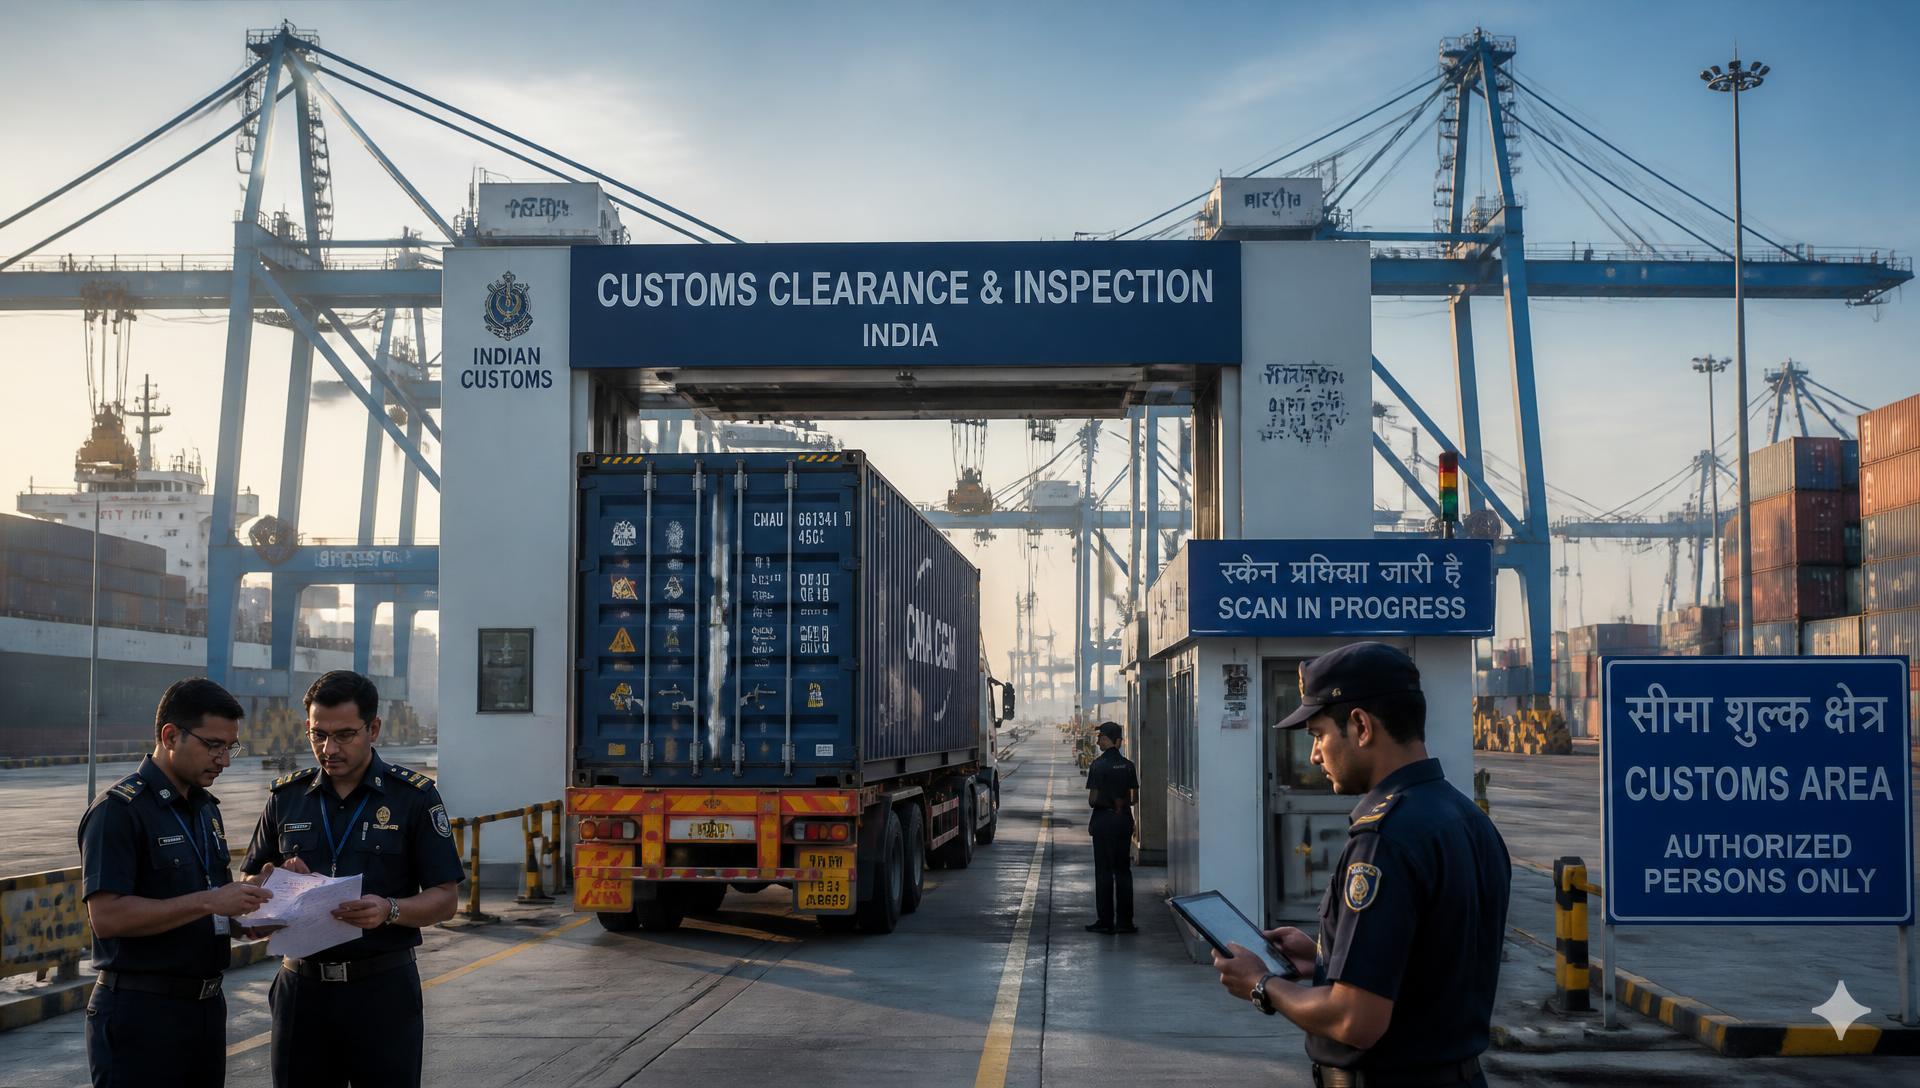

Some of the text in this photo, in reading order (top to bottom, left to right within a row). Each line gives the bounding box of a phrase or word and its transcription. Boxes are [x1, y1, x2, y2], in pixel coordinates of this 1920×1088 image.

[597, 268, 1213, 308] CUSTOMS CLEARANCE & INSPECTION
[863, 322, 939, 348] INDIA
[473, 346, 541, 366] INDIAN
[460, 369, 553, 390] CUSTOMS
[753, 511, 784, 527] CMAU
[1219, 554, 1280, 584] स्कैन
[1378, 553, 1434, 584] जारी
[1443, 553, 1463, 588] है
[1218, 596, 1466, 620] SCAN IN PROGRESS
[906, 603, 933, 665] CMA
[1625, 682, 1889, 748] सीमा शुल्क क्षेत्र
[1624, 765, 1894, 802] CUSTOMS AREA
[1663, 833, 1852, 859] AUTHORIZED
[1644, 867, 1877, 894] PERSONS ONLY
